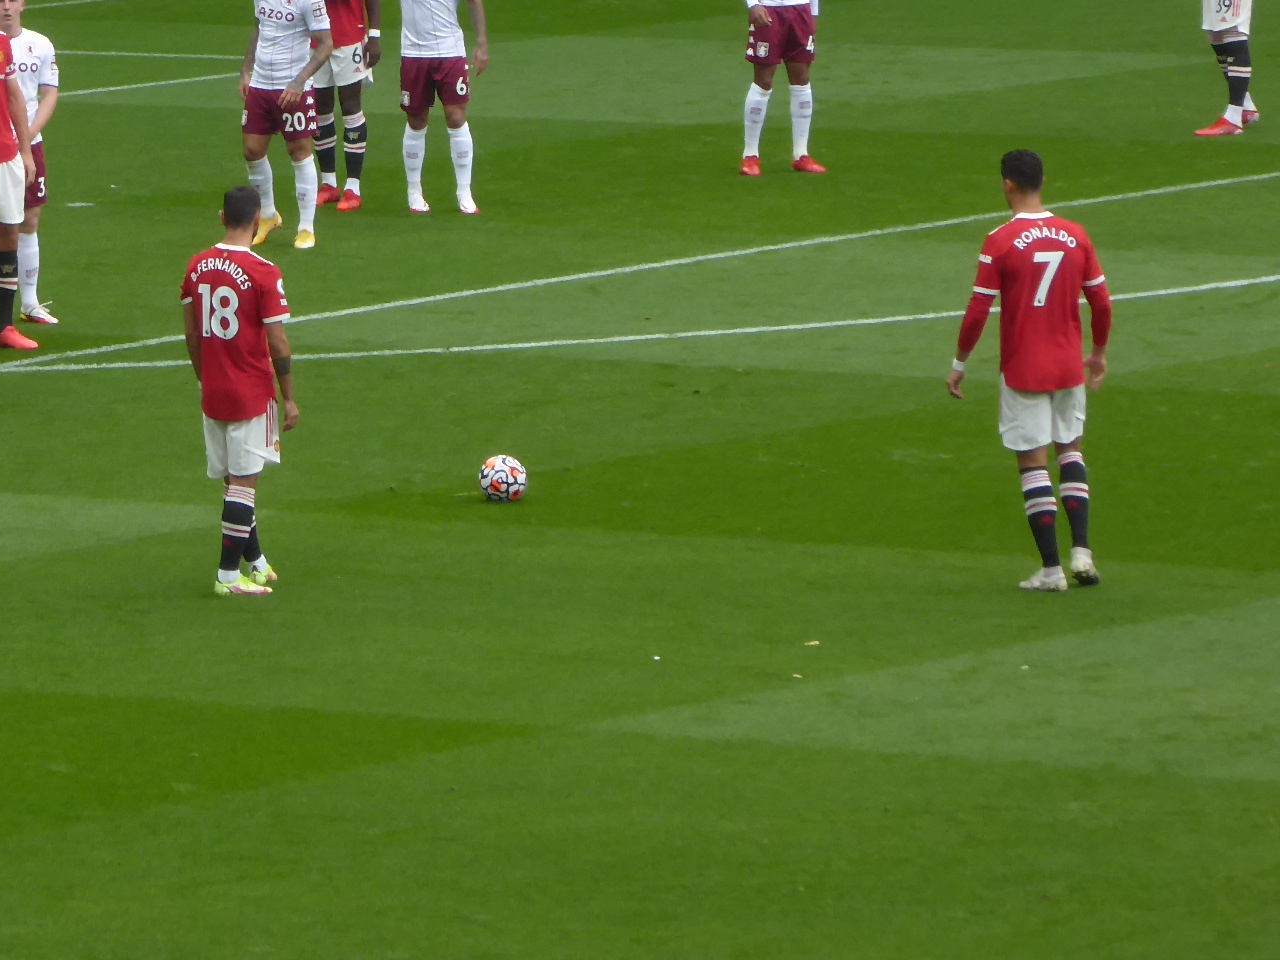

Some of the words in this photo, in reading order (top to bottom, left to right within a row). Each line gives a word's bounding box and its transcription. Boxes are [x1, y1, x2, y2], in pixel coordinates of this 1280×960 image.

[257, 6, 295, 22] AZOO
[352, 46, 362, 64] 6
[282, 112, 306, 132] 20
[1013, 226, 1077, 251] RONALDO
[190, 257, 252, 291] B.FERNANDES
[1033, 251, 1065, 307] 7
[197, 283, 240, 340] 18
